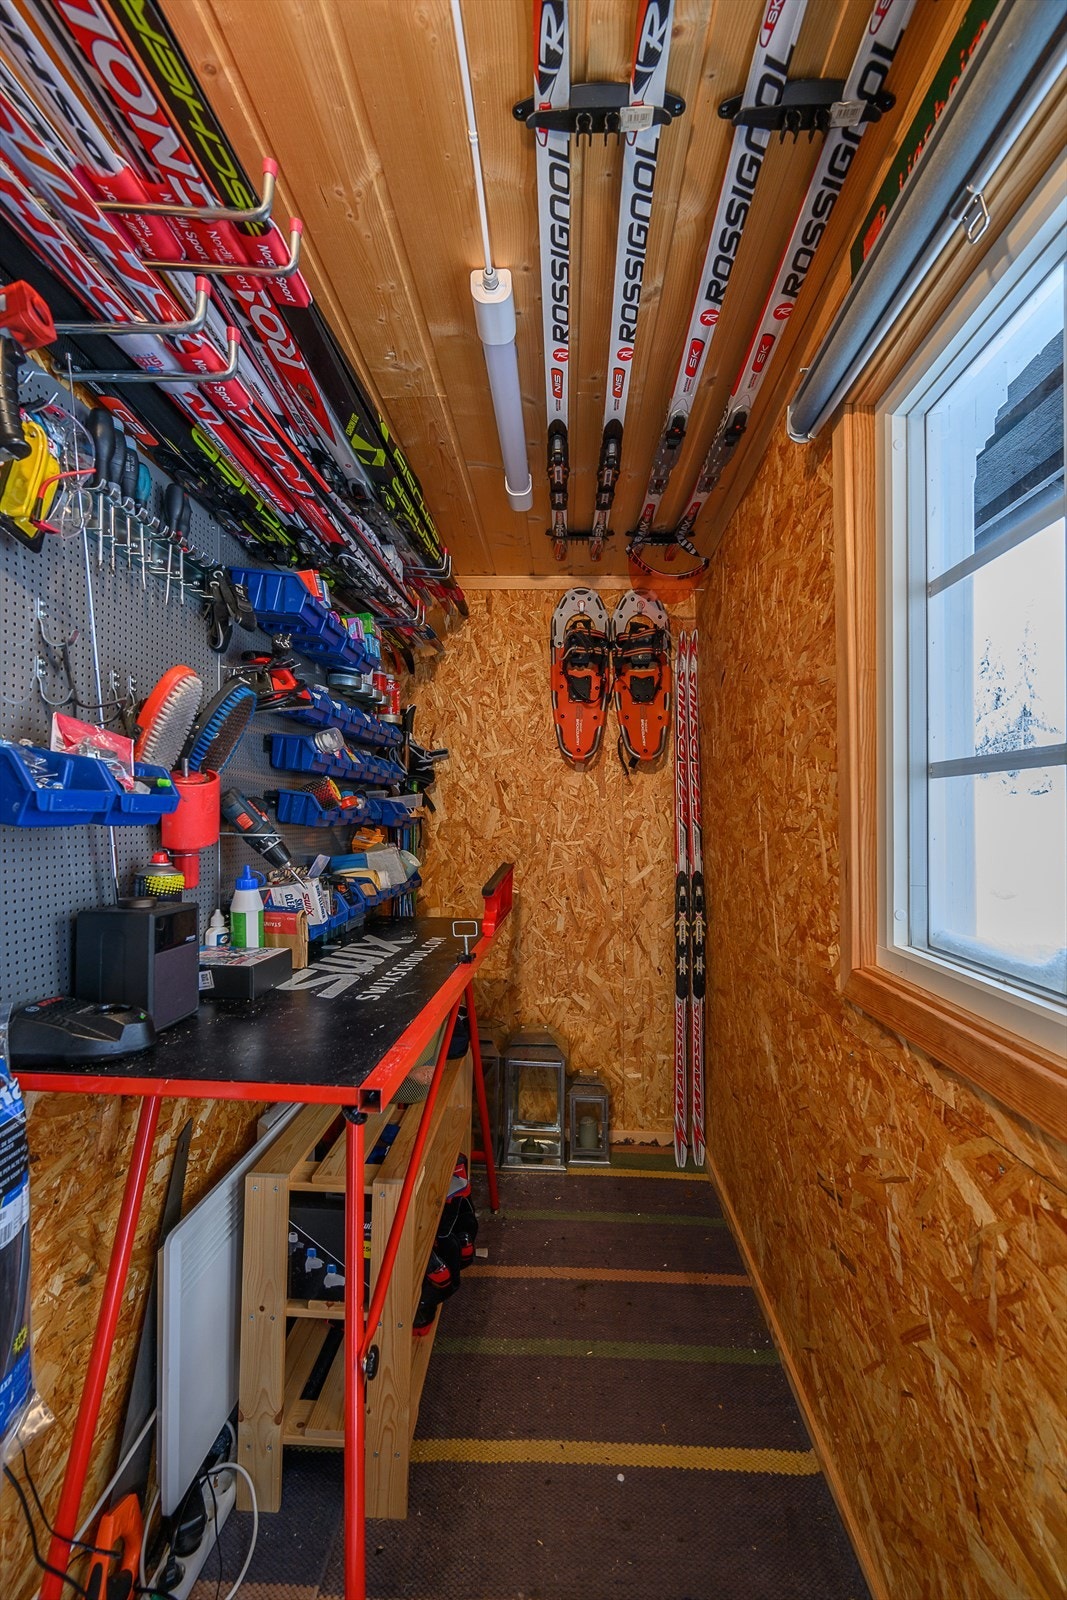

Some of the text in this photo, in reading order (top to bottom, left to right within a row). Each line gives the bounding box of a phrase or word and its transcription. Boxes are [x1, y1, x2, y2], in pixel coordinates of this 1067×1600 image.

[548, 138, 570, 343] ROSSIGNOL
[618, 138, 660, 343] ROSSIGNOL
[688, 346, 701, 368] SK
[678, 671, 687, 821] MADSHUS
[689, 671, 701, 822] MADSHUS
[356, 936, 447, 1001] SWIXSCHOOL.COM
